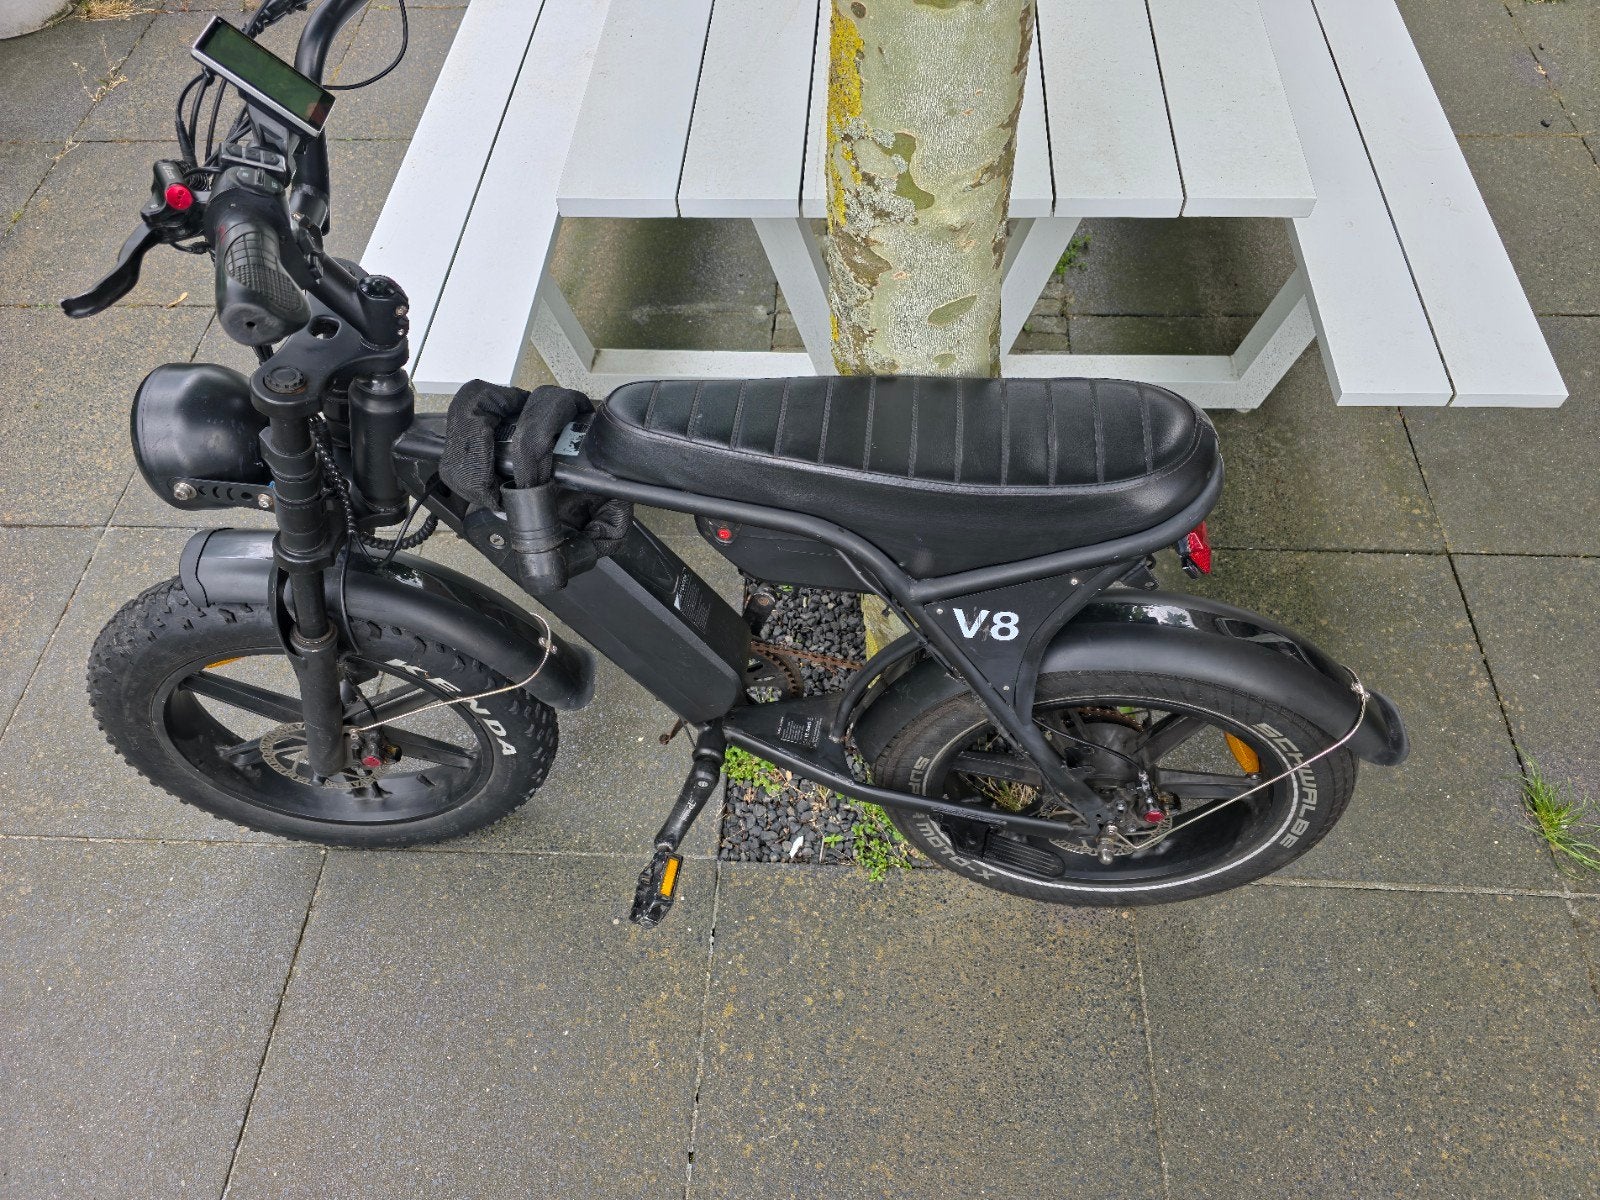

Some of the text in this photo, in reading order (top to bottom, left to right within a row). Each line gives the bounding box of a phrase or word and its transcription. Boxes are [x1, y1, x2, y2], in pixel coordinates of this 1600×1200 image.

[953, 607, 1019, 641] V8
[384, 658, 517, 756] KENDA
[1251, 722, 1318, 849] SCHWALBE
